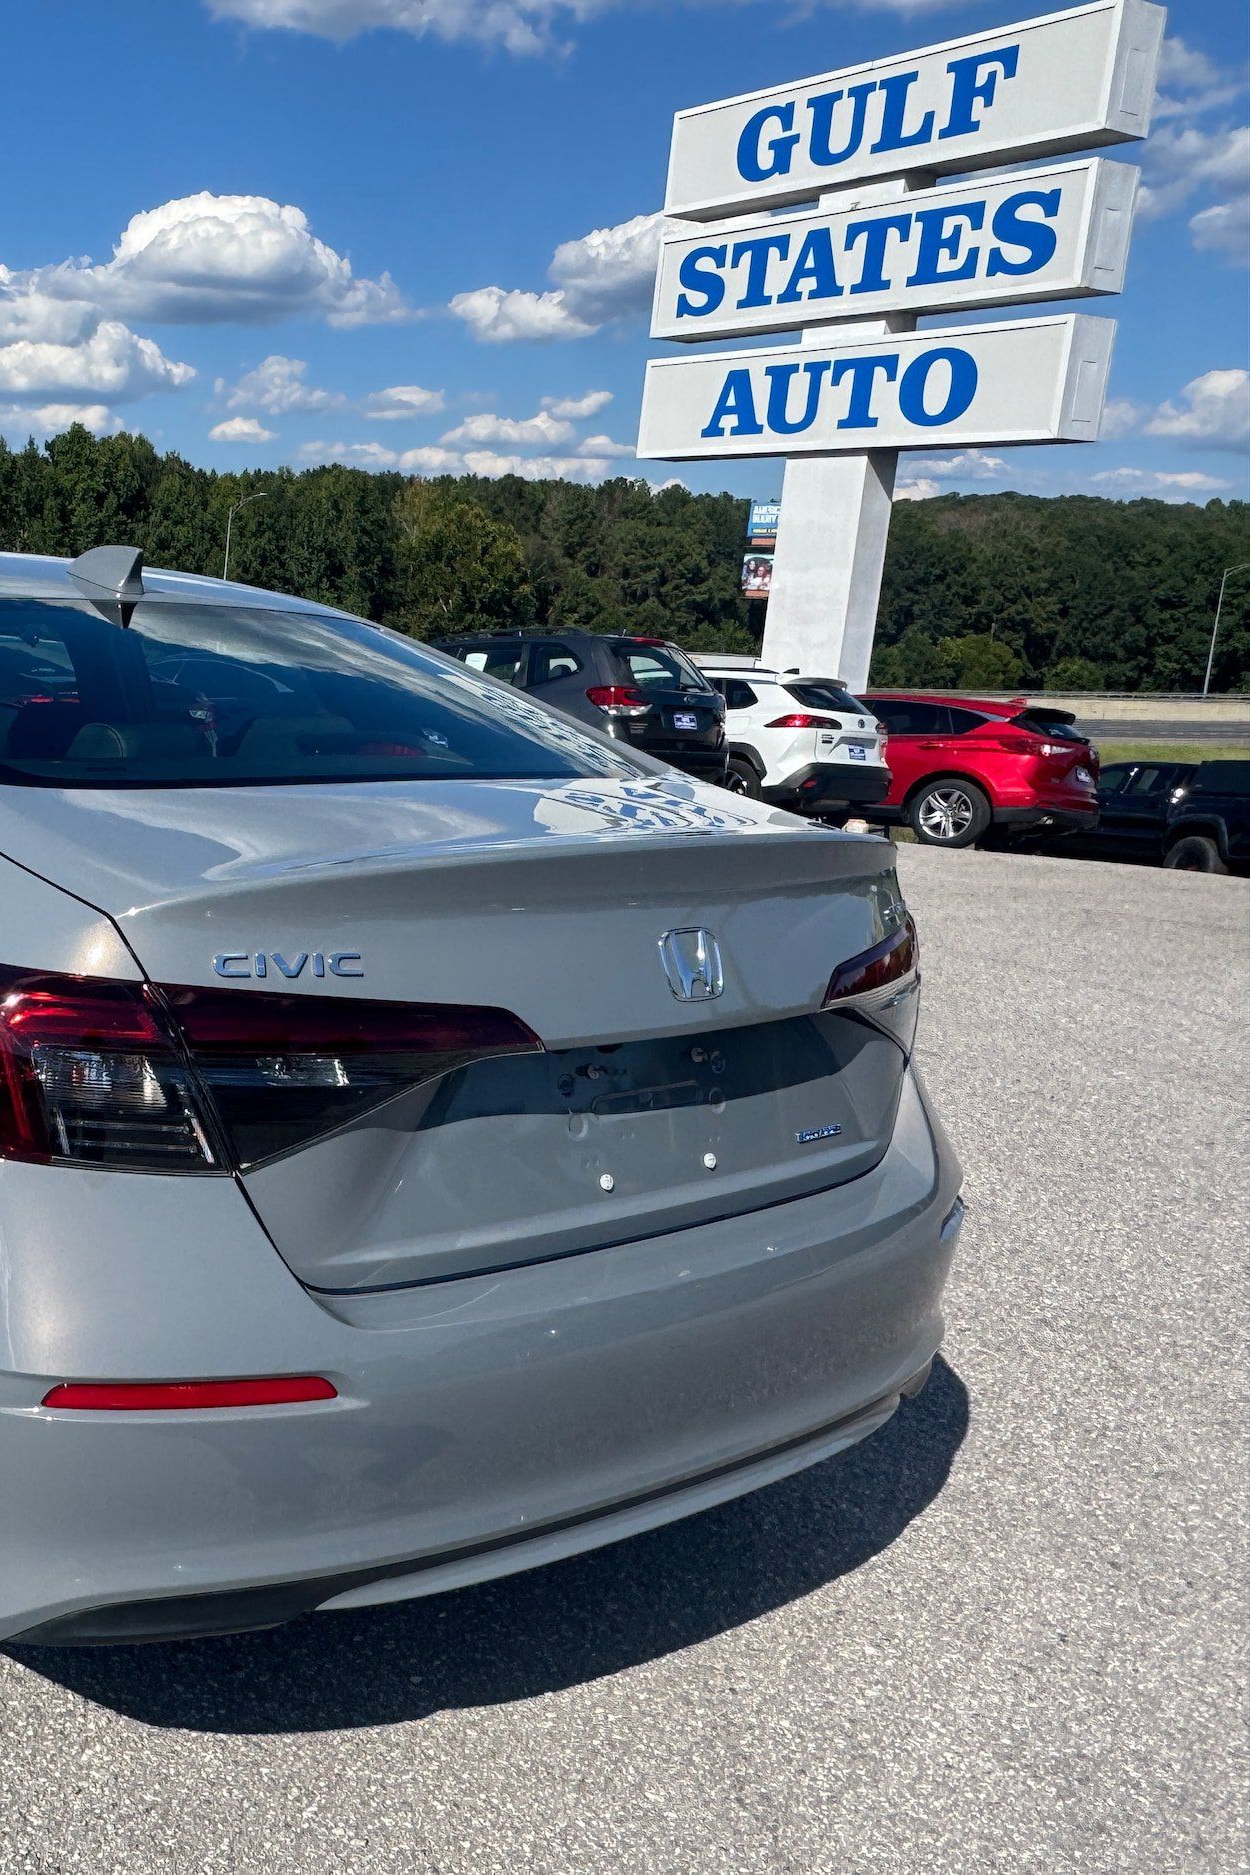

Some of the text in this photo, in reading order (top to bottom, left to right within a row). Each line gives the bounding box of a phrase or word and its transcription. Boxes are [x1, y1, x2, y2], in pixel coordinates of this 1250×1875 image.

[737, 44, 1020, 182] GULF
[676, 188, 1062, 318] STATES
[701, 347, 979, 438] AUTO
[212, 952, 364, 978] CIVIC
